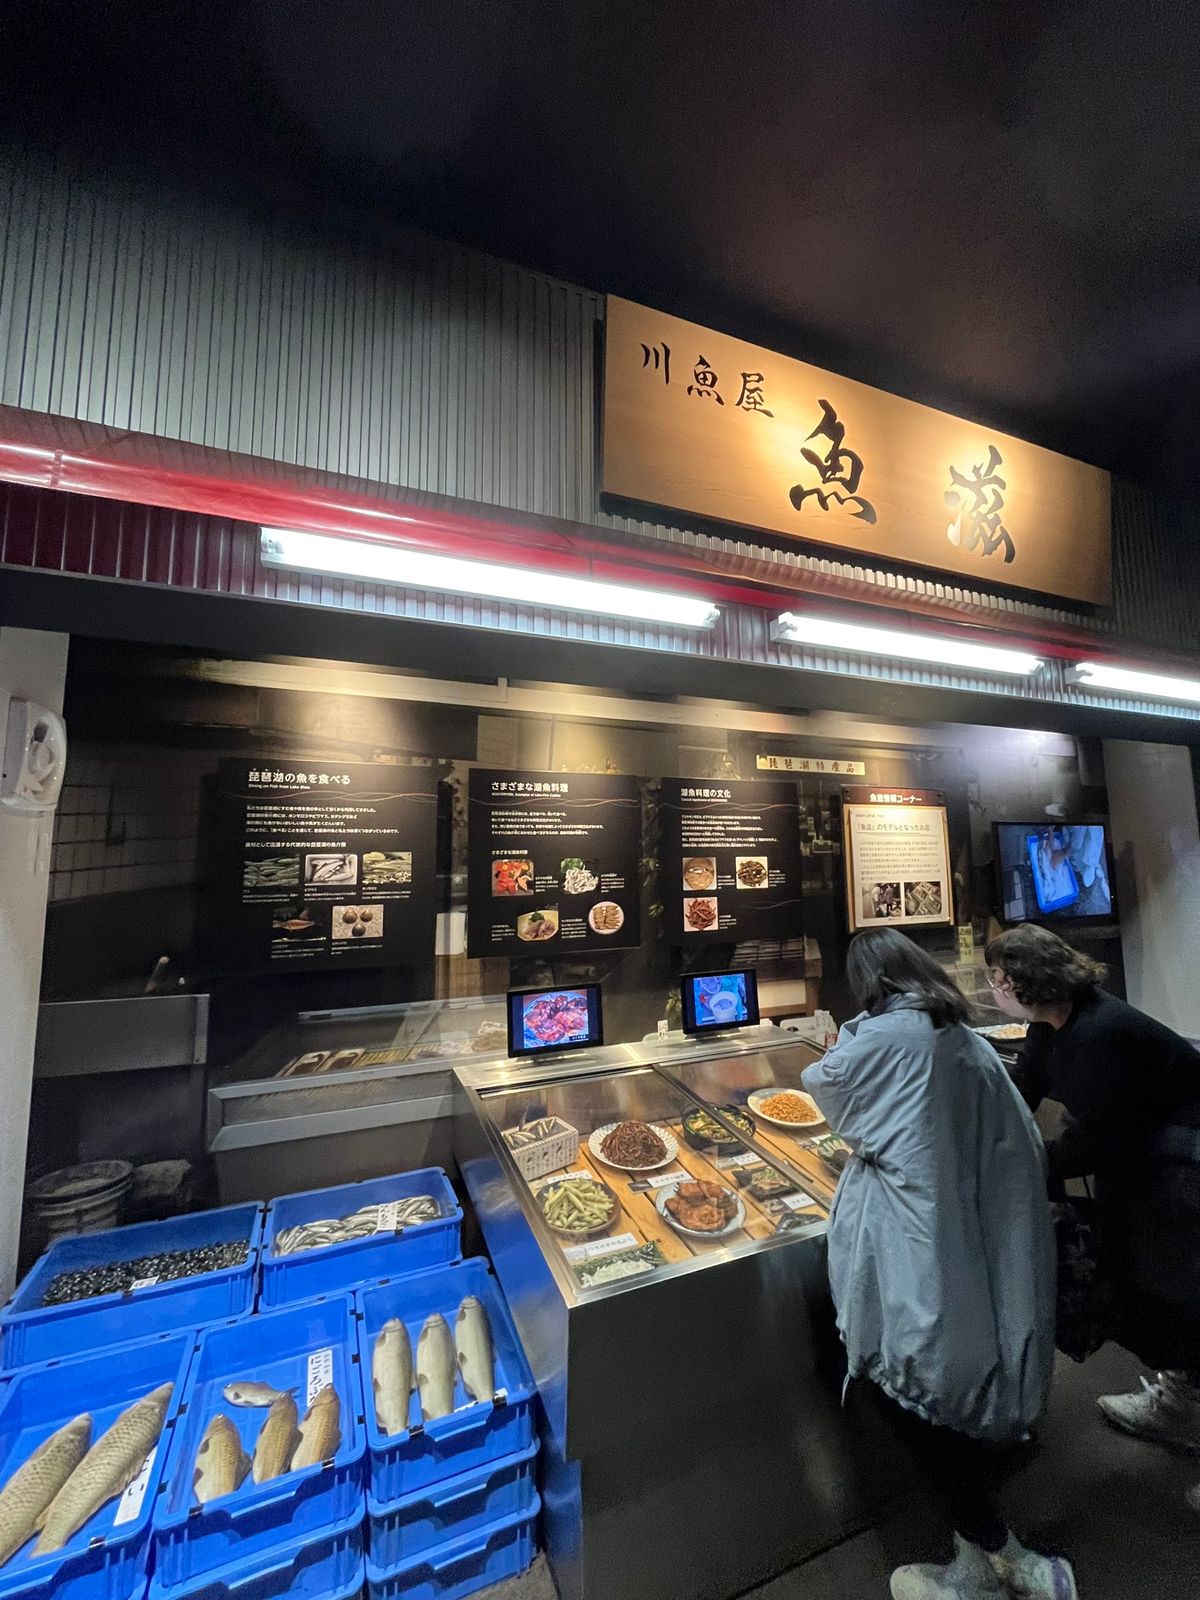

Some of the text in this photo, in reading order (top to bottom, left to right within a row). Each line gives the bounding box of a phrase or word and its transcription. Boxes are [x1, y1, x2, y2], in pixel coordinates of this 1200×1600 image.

[640, 342, 774, 418] 川魚屋
[768, 757, 855, 773] 琵琶湖特産品
[248, 770, 351, 785] 琵琶湖の魚を食べる
[491, 781, 569, 793] さまざまな湖魚料理
[680, 788, 732, 798] 湖魚料理の文化
